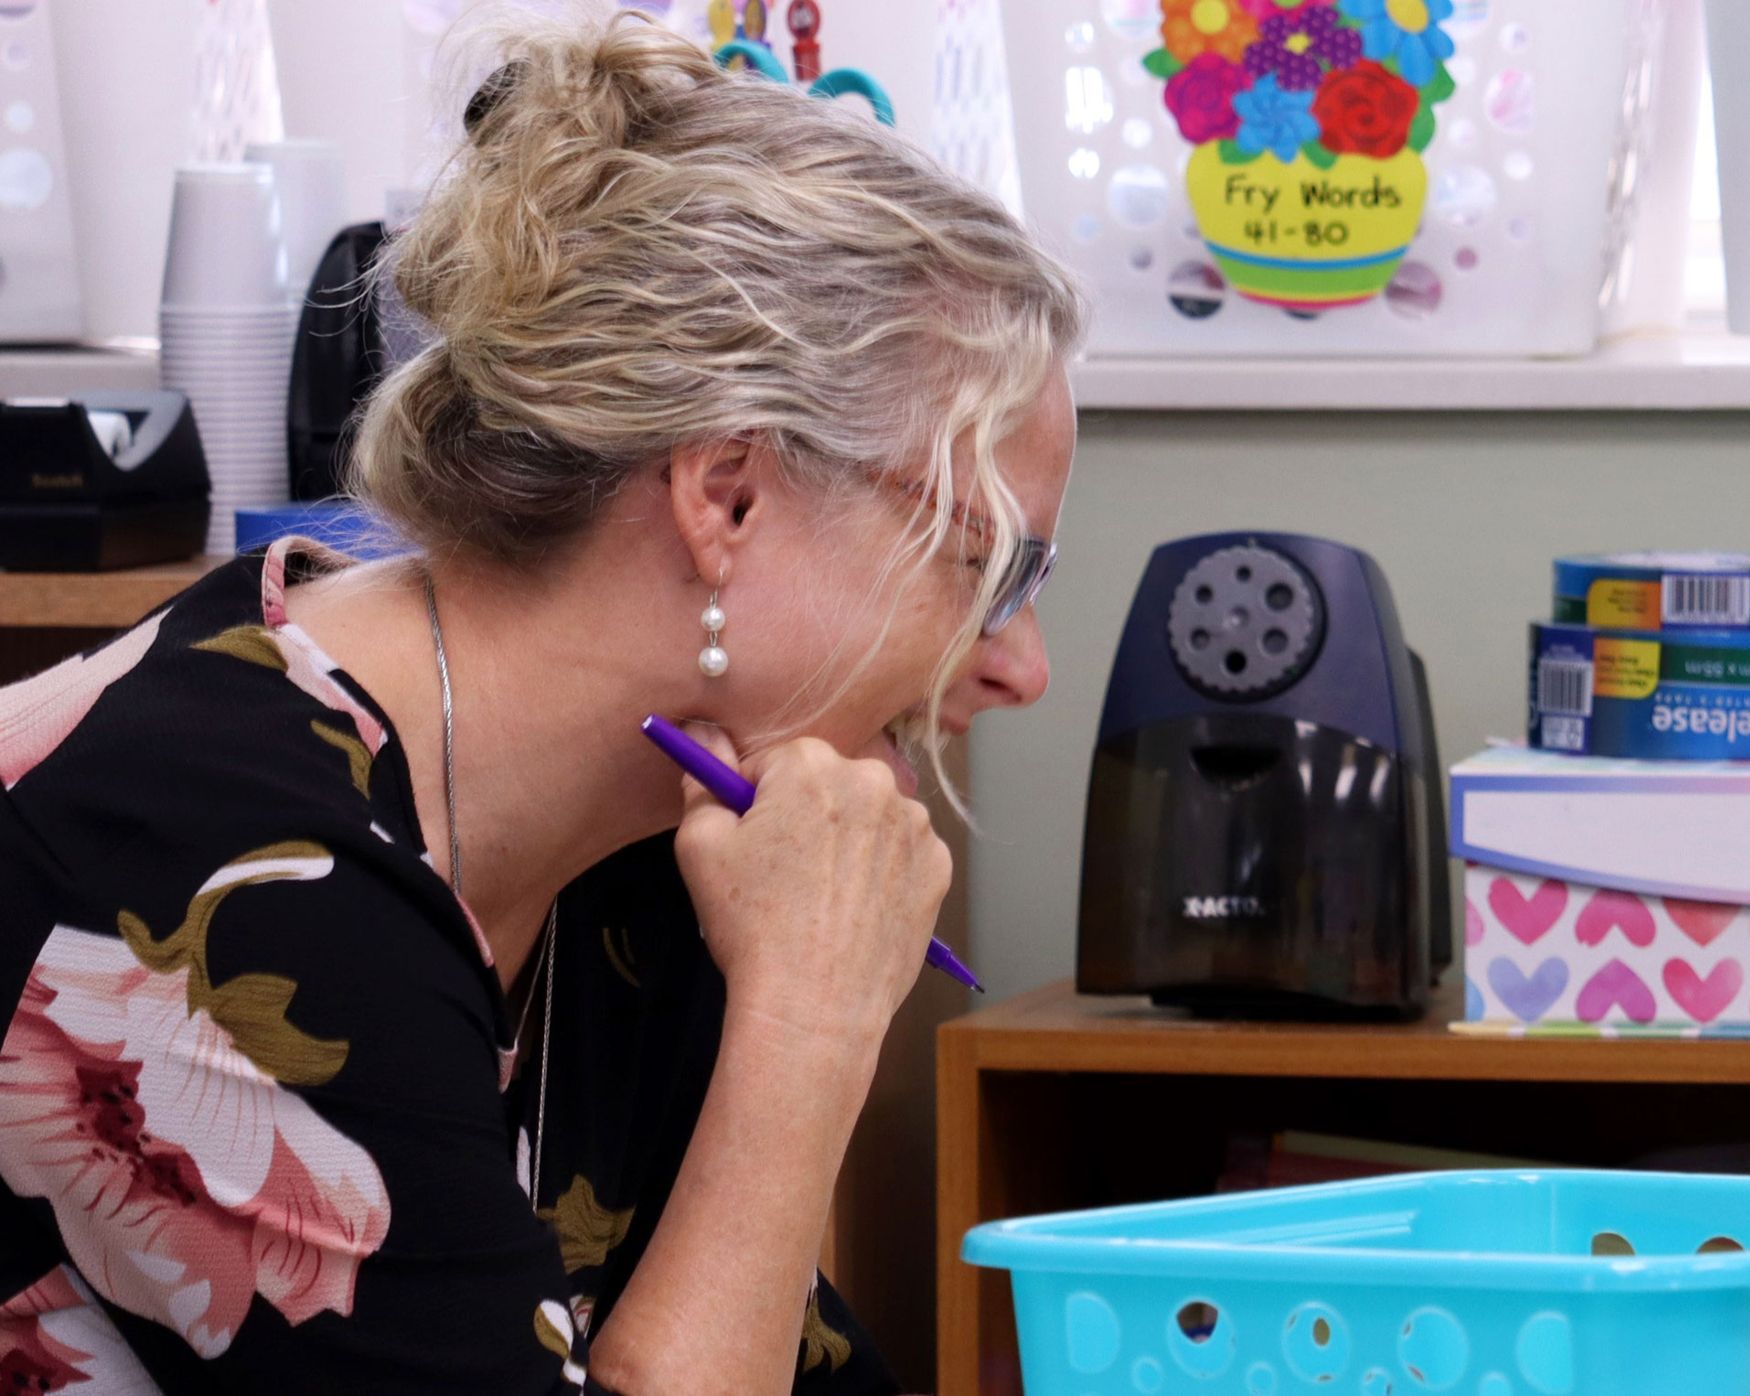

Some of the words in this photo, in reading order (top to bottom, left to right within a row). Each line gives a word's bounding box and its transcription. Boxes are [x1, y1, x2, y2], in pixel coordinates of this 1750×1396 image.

[1225, 173, 1280, 215] Fry
[1300, 173, 1402, 209] Words
[1244, 220, 1349, 247] 41-80
